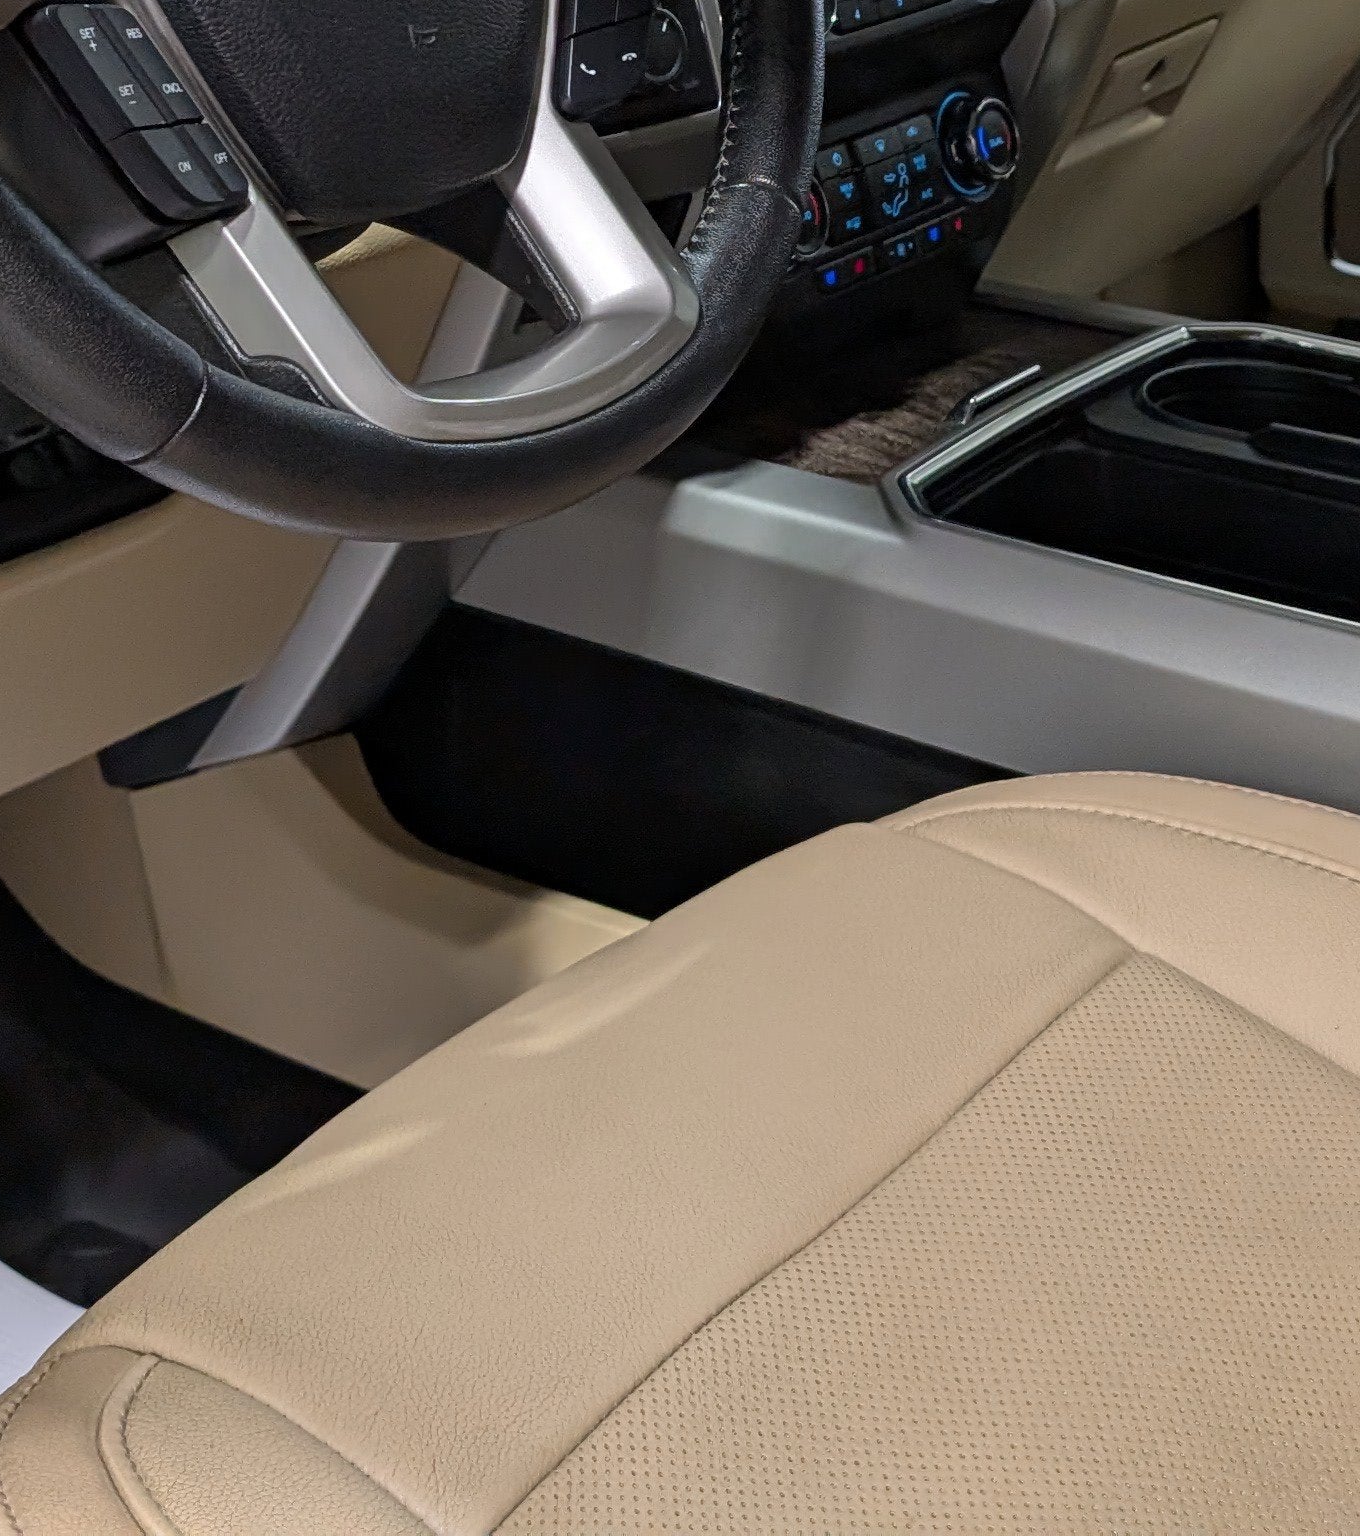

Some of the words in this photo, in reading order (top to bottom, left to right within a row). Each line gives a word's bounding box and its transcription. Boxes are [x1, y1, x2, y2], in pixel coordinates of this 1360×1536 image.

[78, 27, 95, 40] SET
[125, 27, 143, 39] RES
[118, 84, 135, 97] SET
[213, 151, 228, 165] OFF
[177, 160, 192, 173] ON
